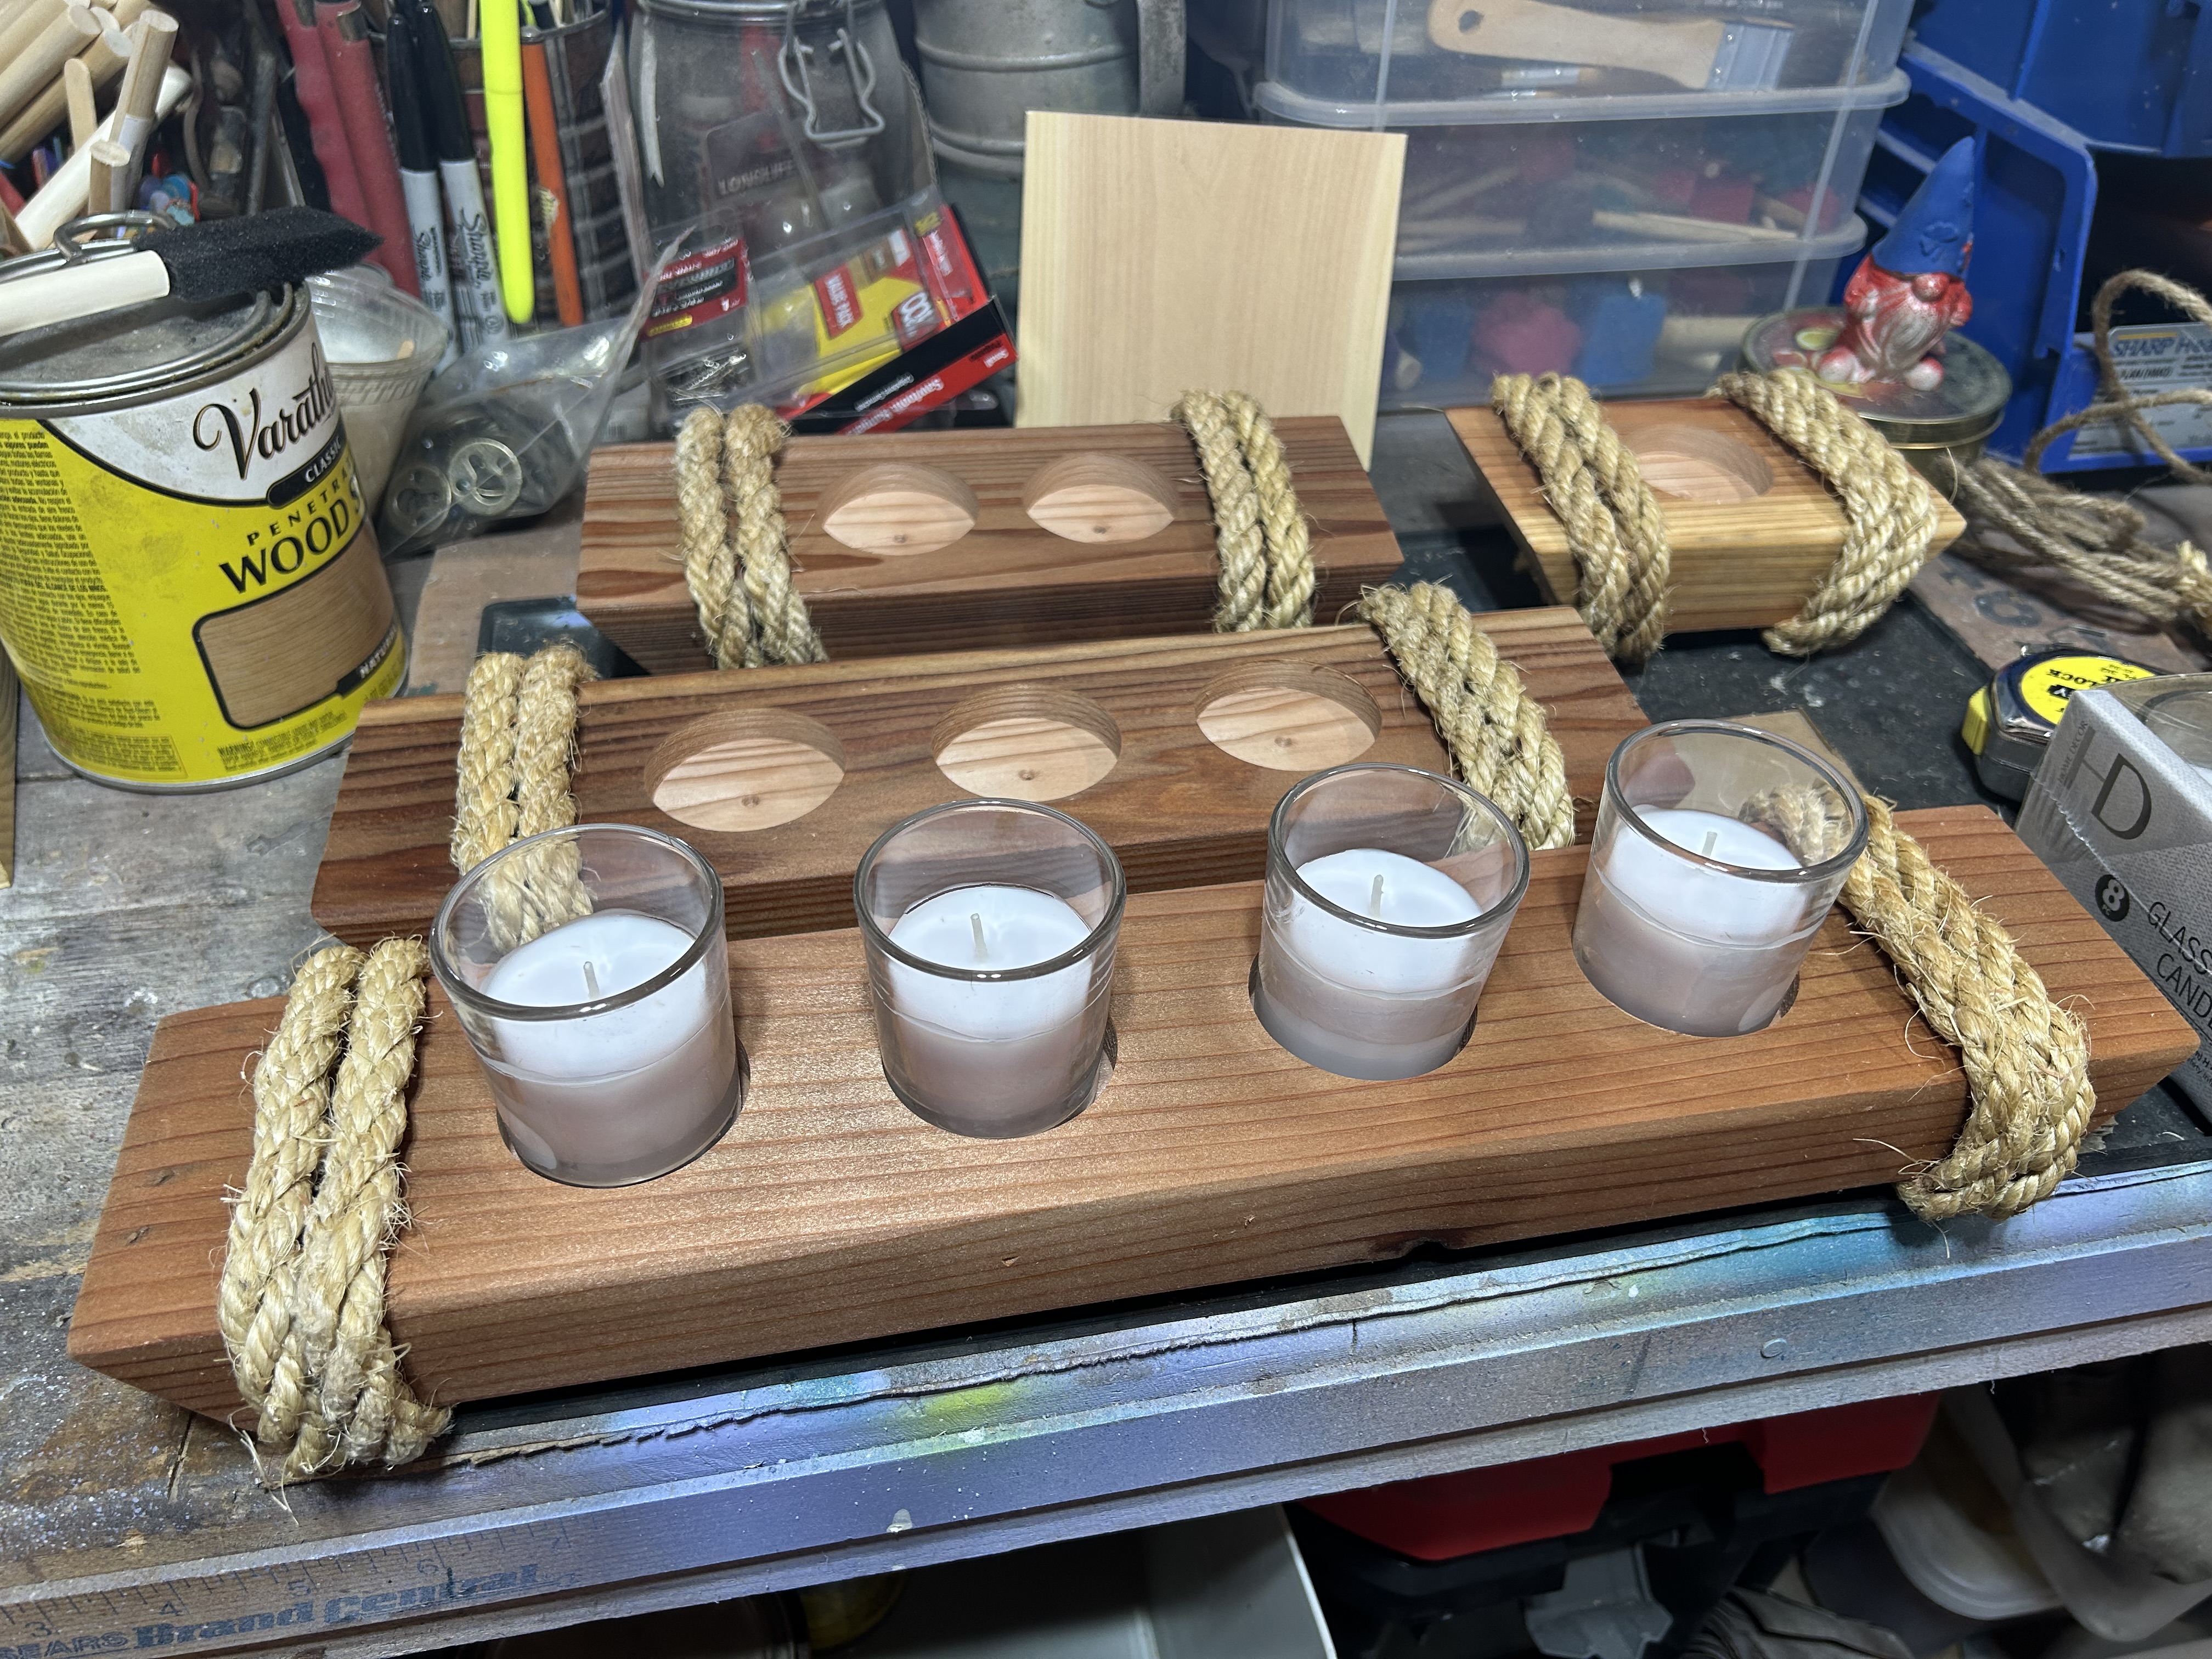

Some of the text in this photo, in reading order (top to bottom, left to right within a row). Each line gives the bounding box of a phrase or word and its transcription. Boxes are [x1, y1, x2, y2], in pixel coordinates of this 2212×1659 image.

[219, 499, 349, 594] WOOD
[2102, 878, 2125, 912] 8
[2147, 901, 2212, 975] GLASS
[2157, 953, 2212, 1030] CAND
[135, 1601, 314, 1649] Brand
[324, 1563, 539, 1624] Central
[159, 1602, 183, 1617] 4
[287, 1579, 311, 1598] 5
[416, 1559, 438, 1575] 6
